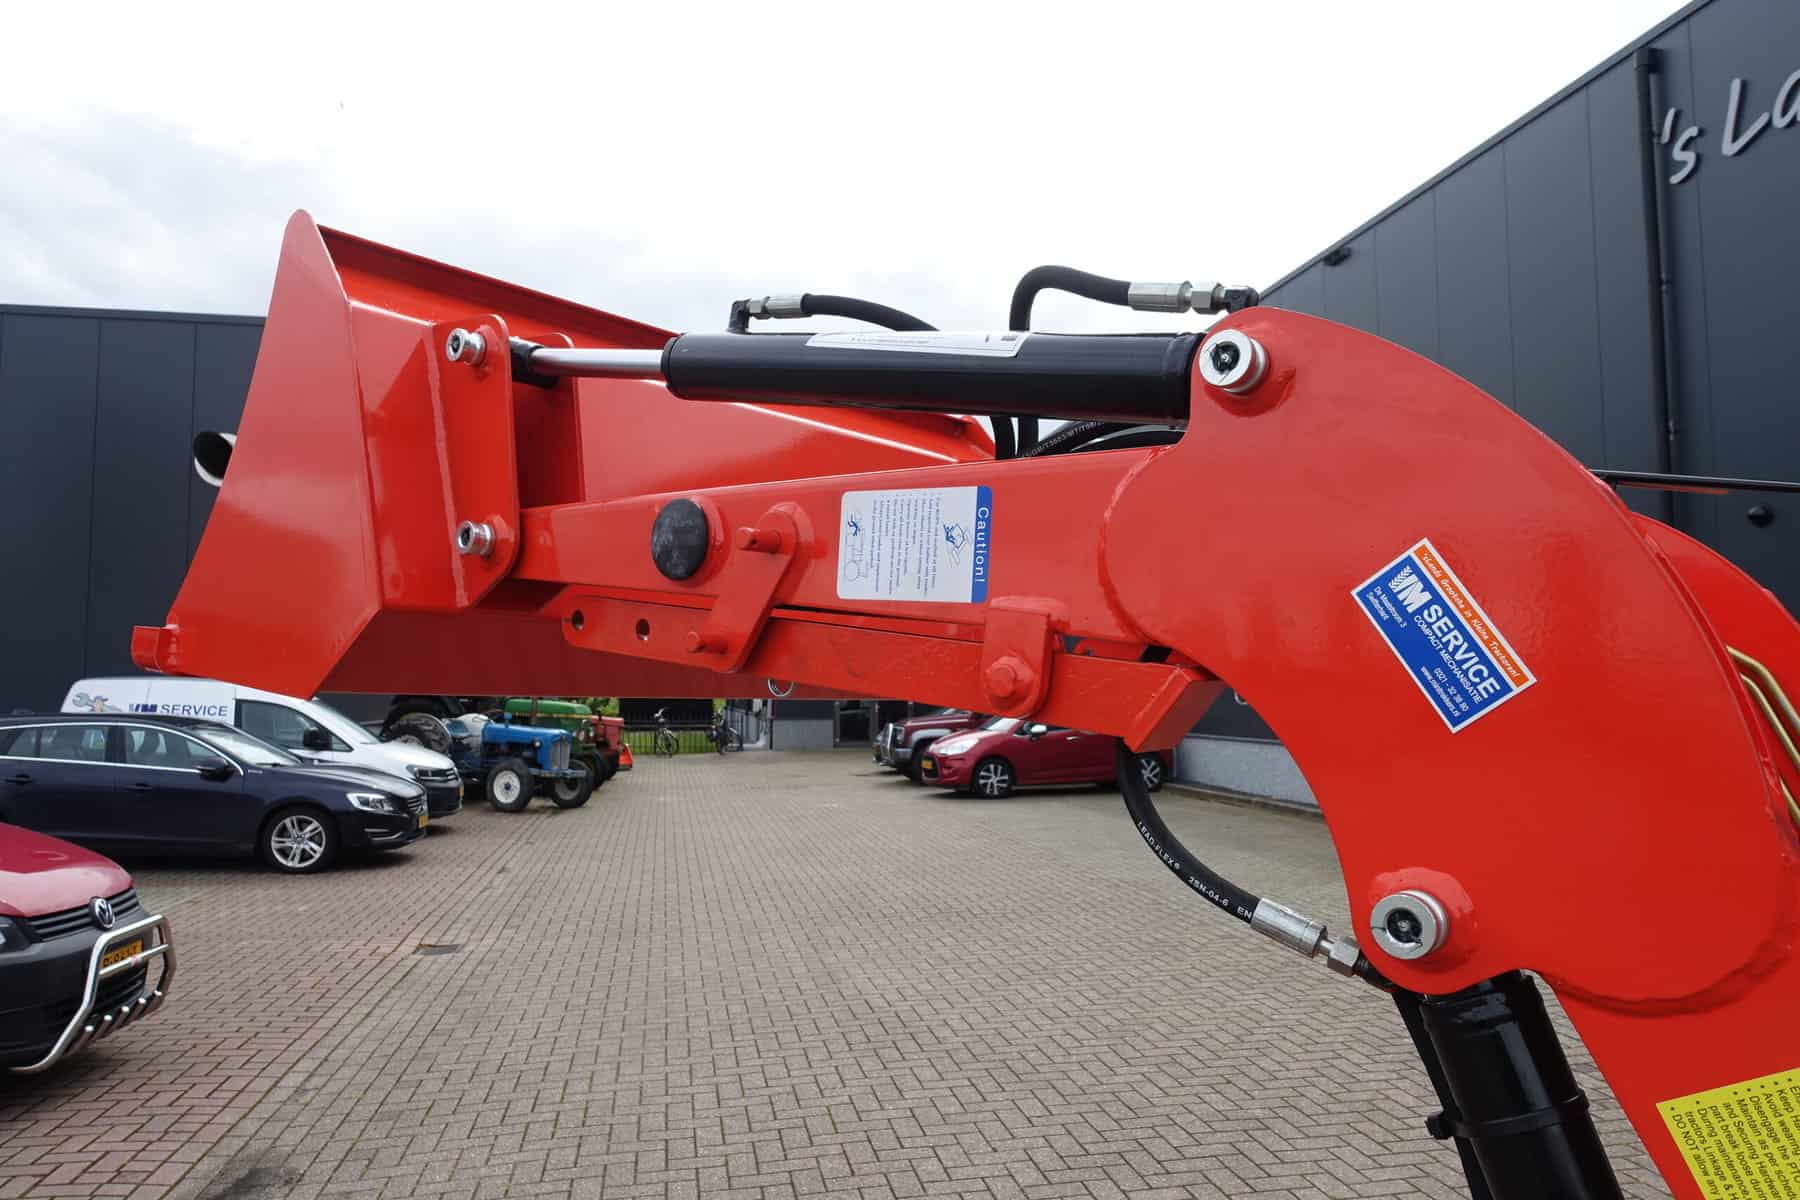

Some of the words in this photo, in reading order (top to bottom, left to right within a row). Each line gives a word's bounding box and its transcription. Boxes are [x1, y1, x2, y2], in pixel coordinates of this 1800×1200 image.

[974, 506, 989, 581] Caution!
[1413, 615, 1443, 649] COMPACT
[1439, 649, 1482, 703] MECHANISATIE
[1423, 604, 1500, 698] SERVICE
[160, 703, 228, 717] SERVICE
[1236, 905, 1252, 920] EN
[1696, 1107, 1717, 1137] During
[1722, 1102, 1738, 1118] and
[1733, 1120, 1759, 1159] Securing
[1735, 1098, 1761, 1136] Maintain
[1757, 1139, 1768, 1150] as
[1763, 1151, 1778, 1166] per
[1748, 1095, 1780, 1143] Disengage
[1776, 1144, 1789, 1160] the
[1762, 1093, 1783, 1118] Avoid
[1777, 1119, 1800, 1155] wearing
[1775, 1088, 1794, 1112] Keep
[1671, 1113, 1686, 1129] DO
[1681, 1130, 1699, 1150] NOT
[1692, 1149, 1710, 1176] allow
[1706, 1179, 1720, 1195] any
[1684, 1111, 1707, 1144] tractors
[1703, 1146, 1726, 1181] Linkage
[1707, 1105, 1725, 1123] part
[1719, 1124, 1739, 1149] break
[1735, 1151, 1753, 1176] loose
